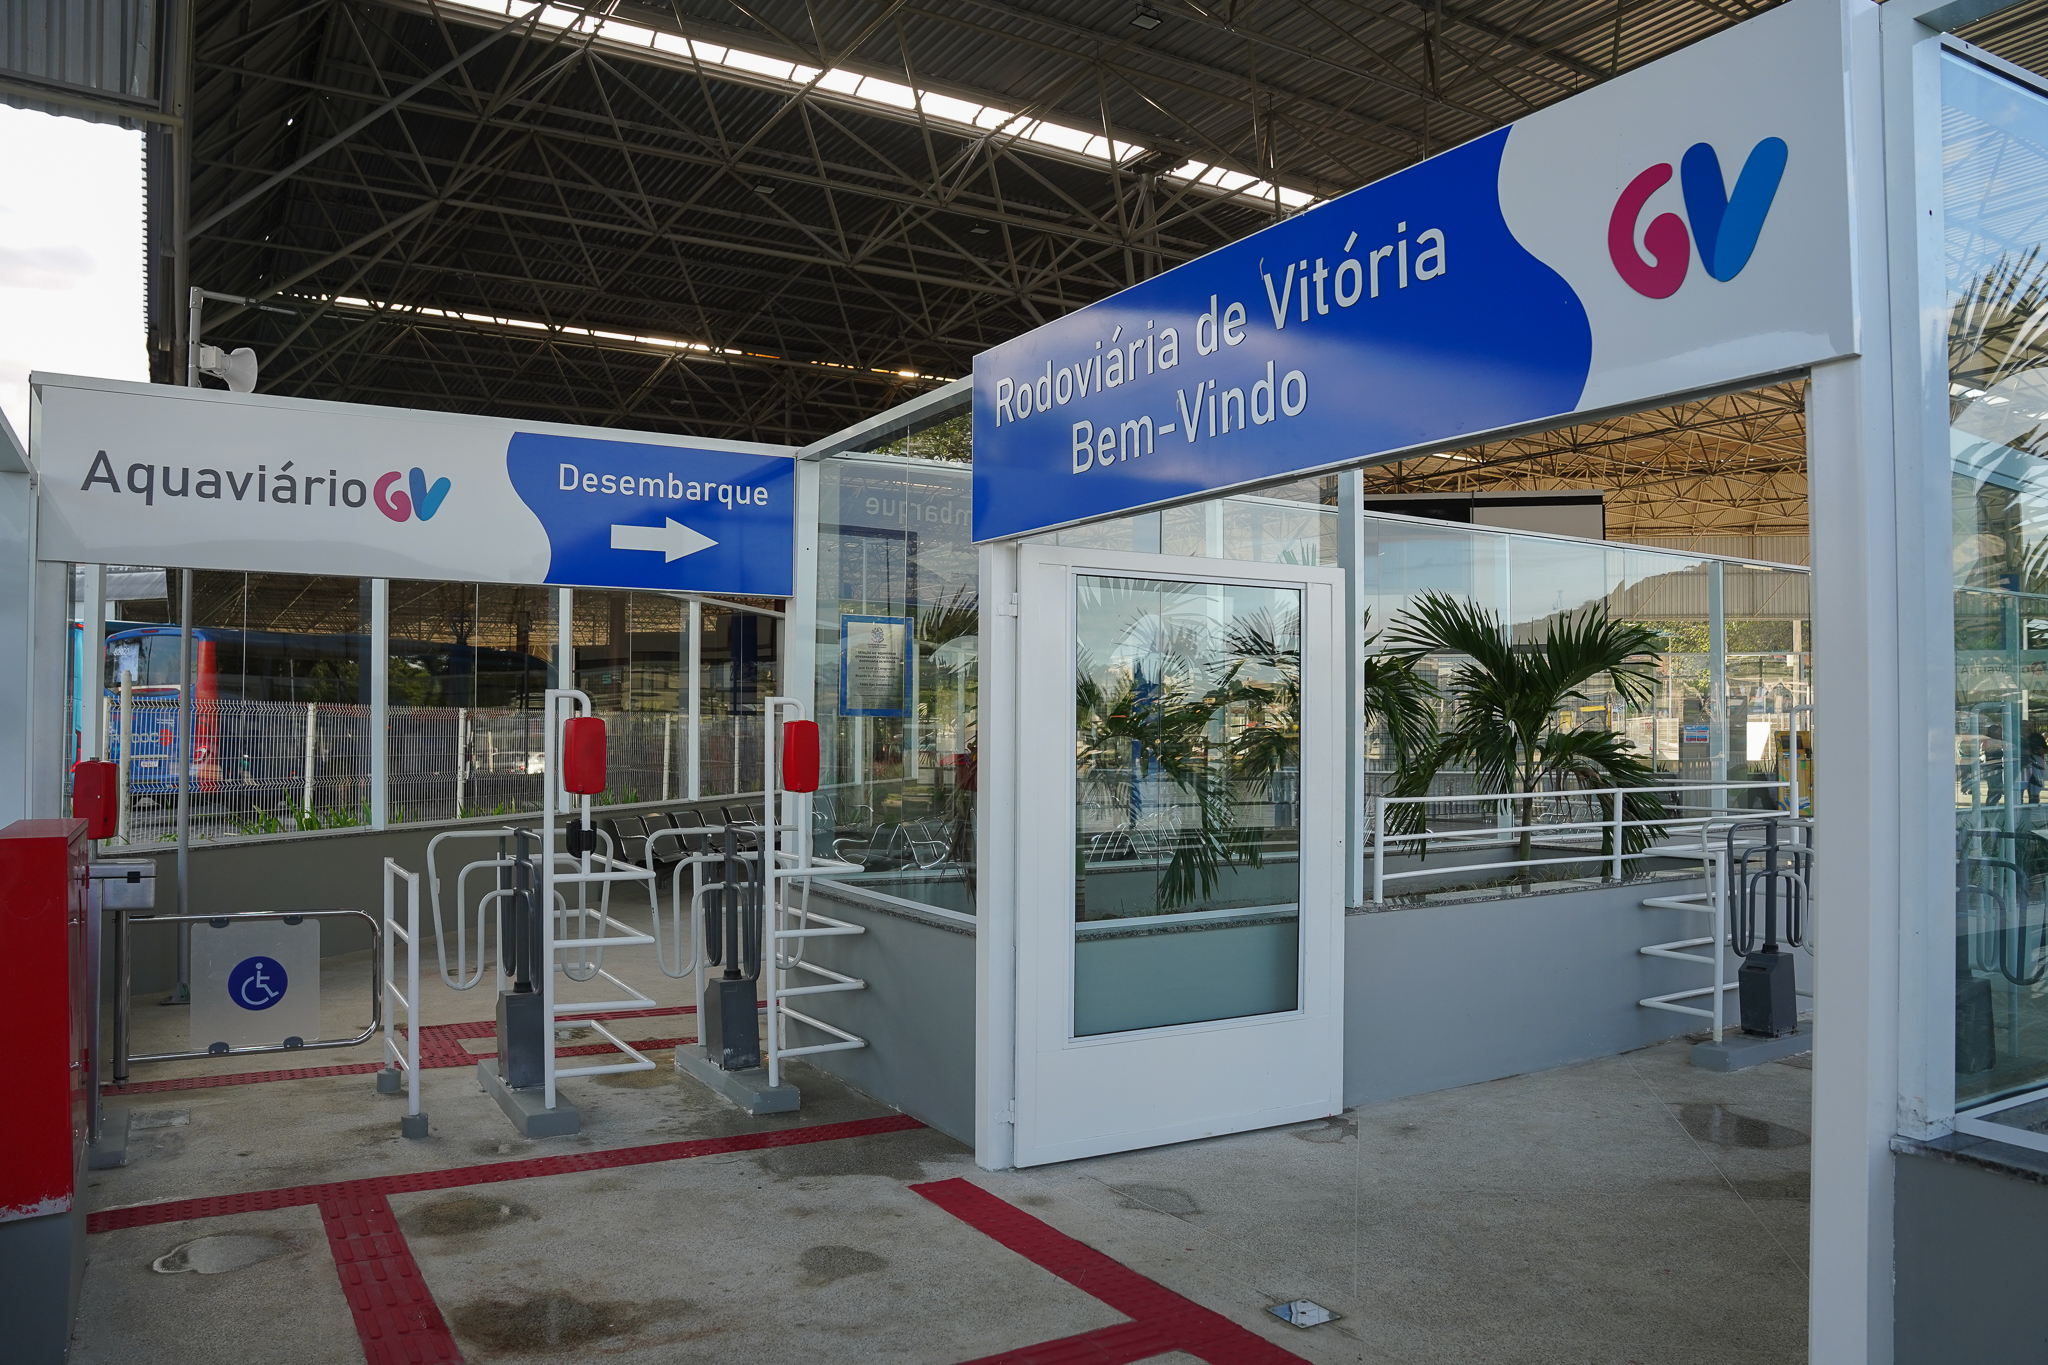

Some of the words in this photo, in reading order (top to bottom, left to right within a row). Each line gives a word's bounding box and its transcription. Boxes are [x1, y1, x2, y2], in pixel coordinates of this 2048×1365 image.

[1608, 136, 1788, 299] GV
[995, 324, 1180, 427] Rodoviária
[1196, 294, 1247, 356] de
[1263, 220, 1447, 330] Vitória
[1071, 360, 1308, 475] Bem-Vindo
[81, 450, 366, 508] Aquaviário
[558, 462, 769, 511] Desembarque
